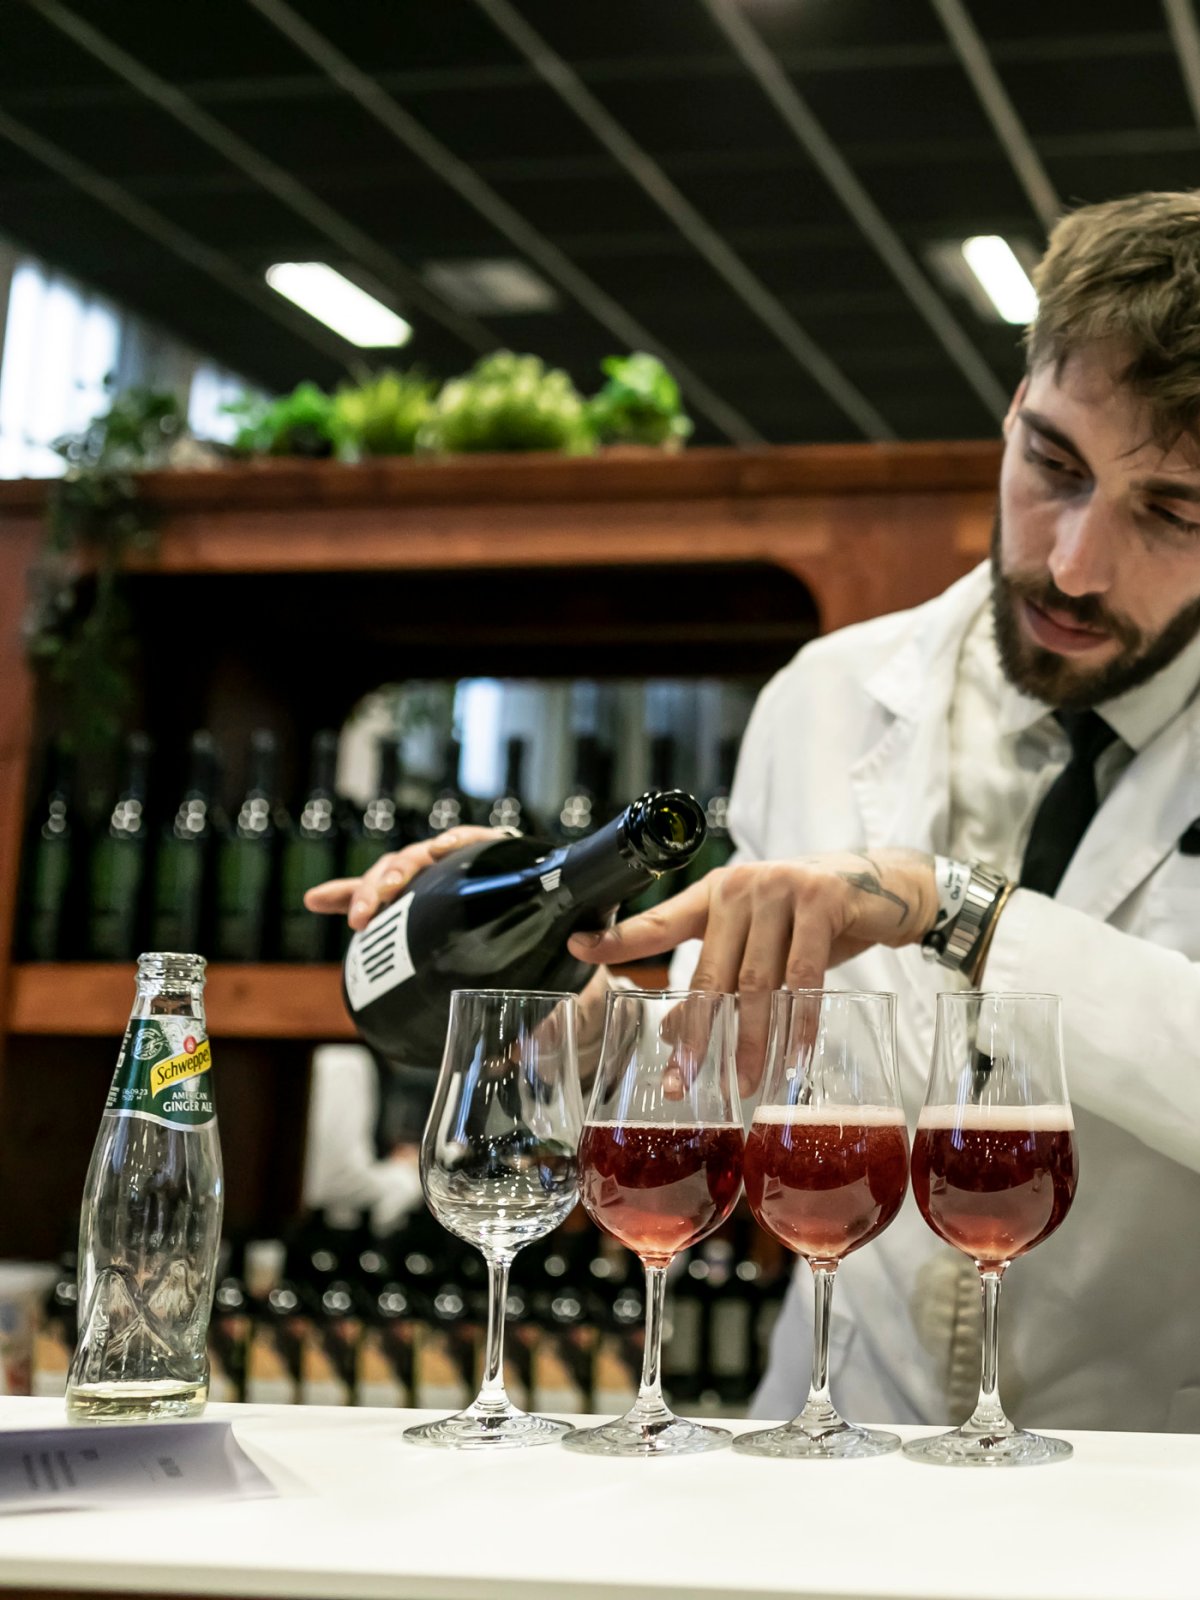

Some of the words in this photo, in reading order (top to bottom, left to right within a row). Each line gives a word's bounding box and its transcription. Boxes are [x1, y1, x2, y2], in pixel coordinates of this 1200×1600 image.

[157, 1048, 210, 1085] Schweppe
[162, 1101, 200, 1112] GINGER
[201, 1102, 213, 1113] ALE
